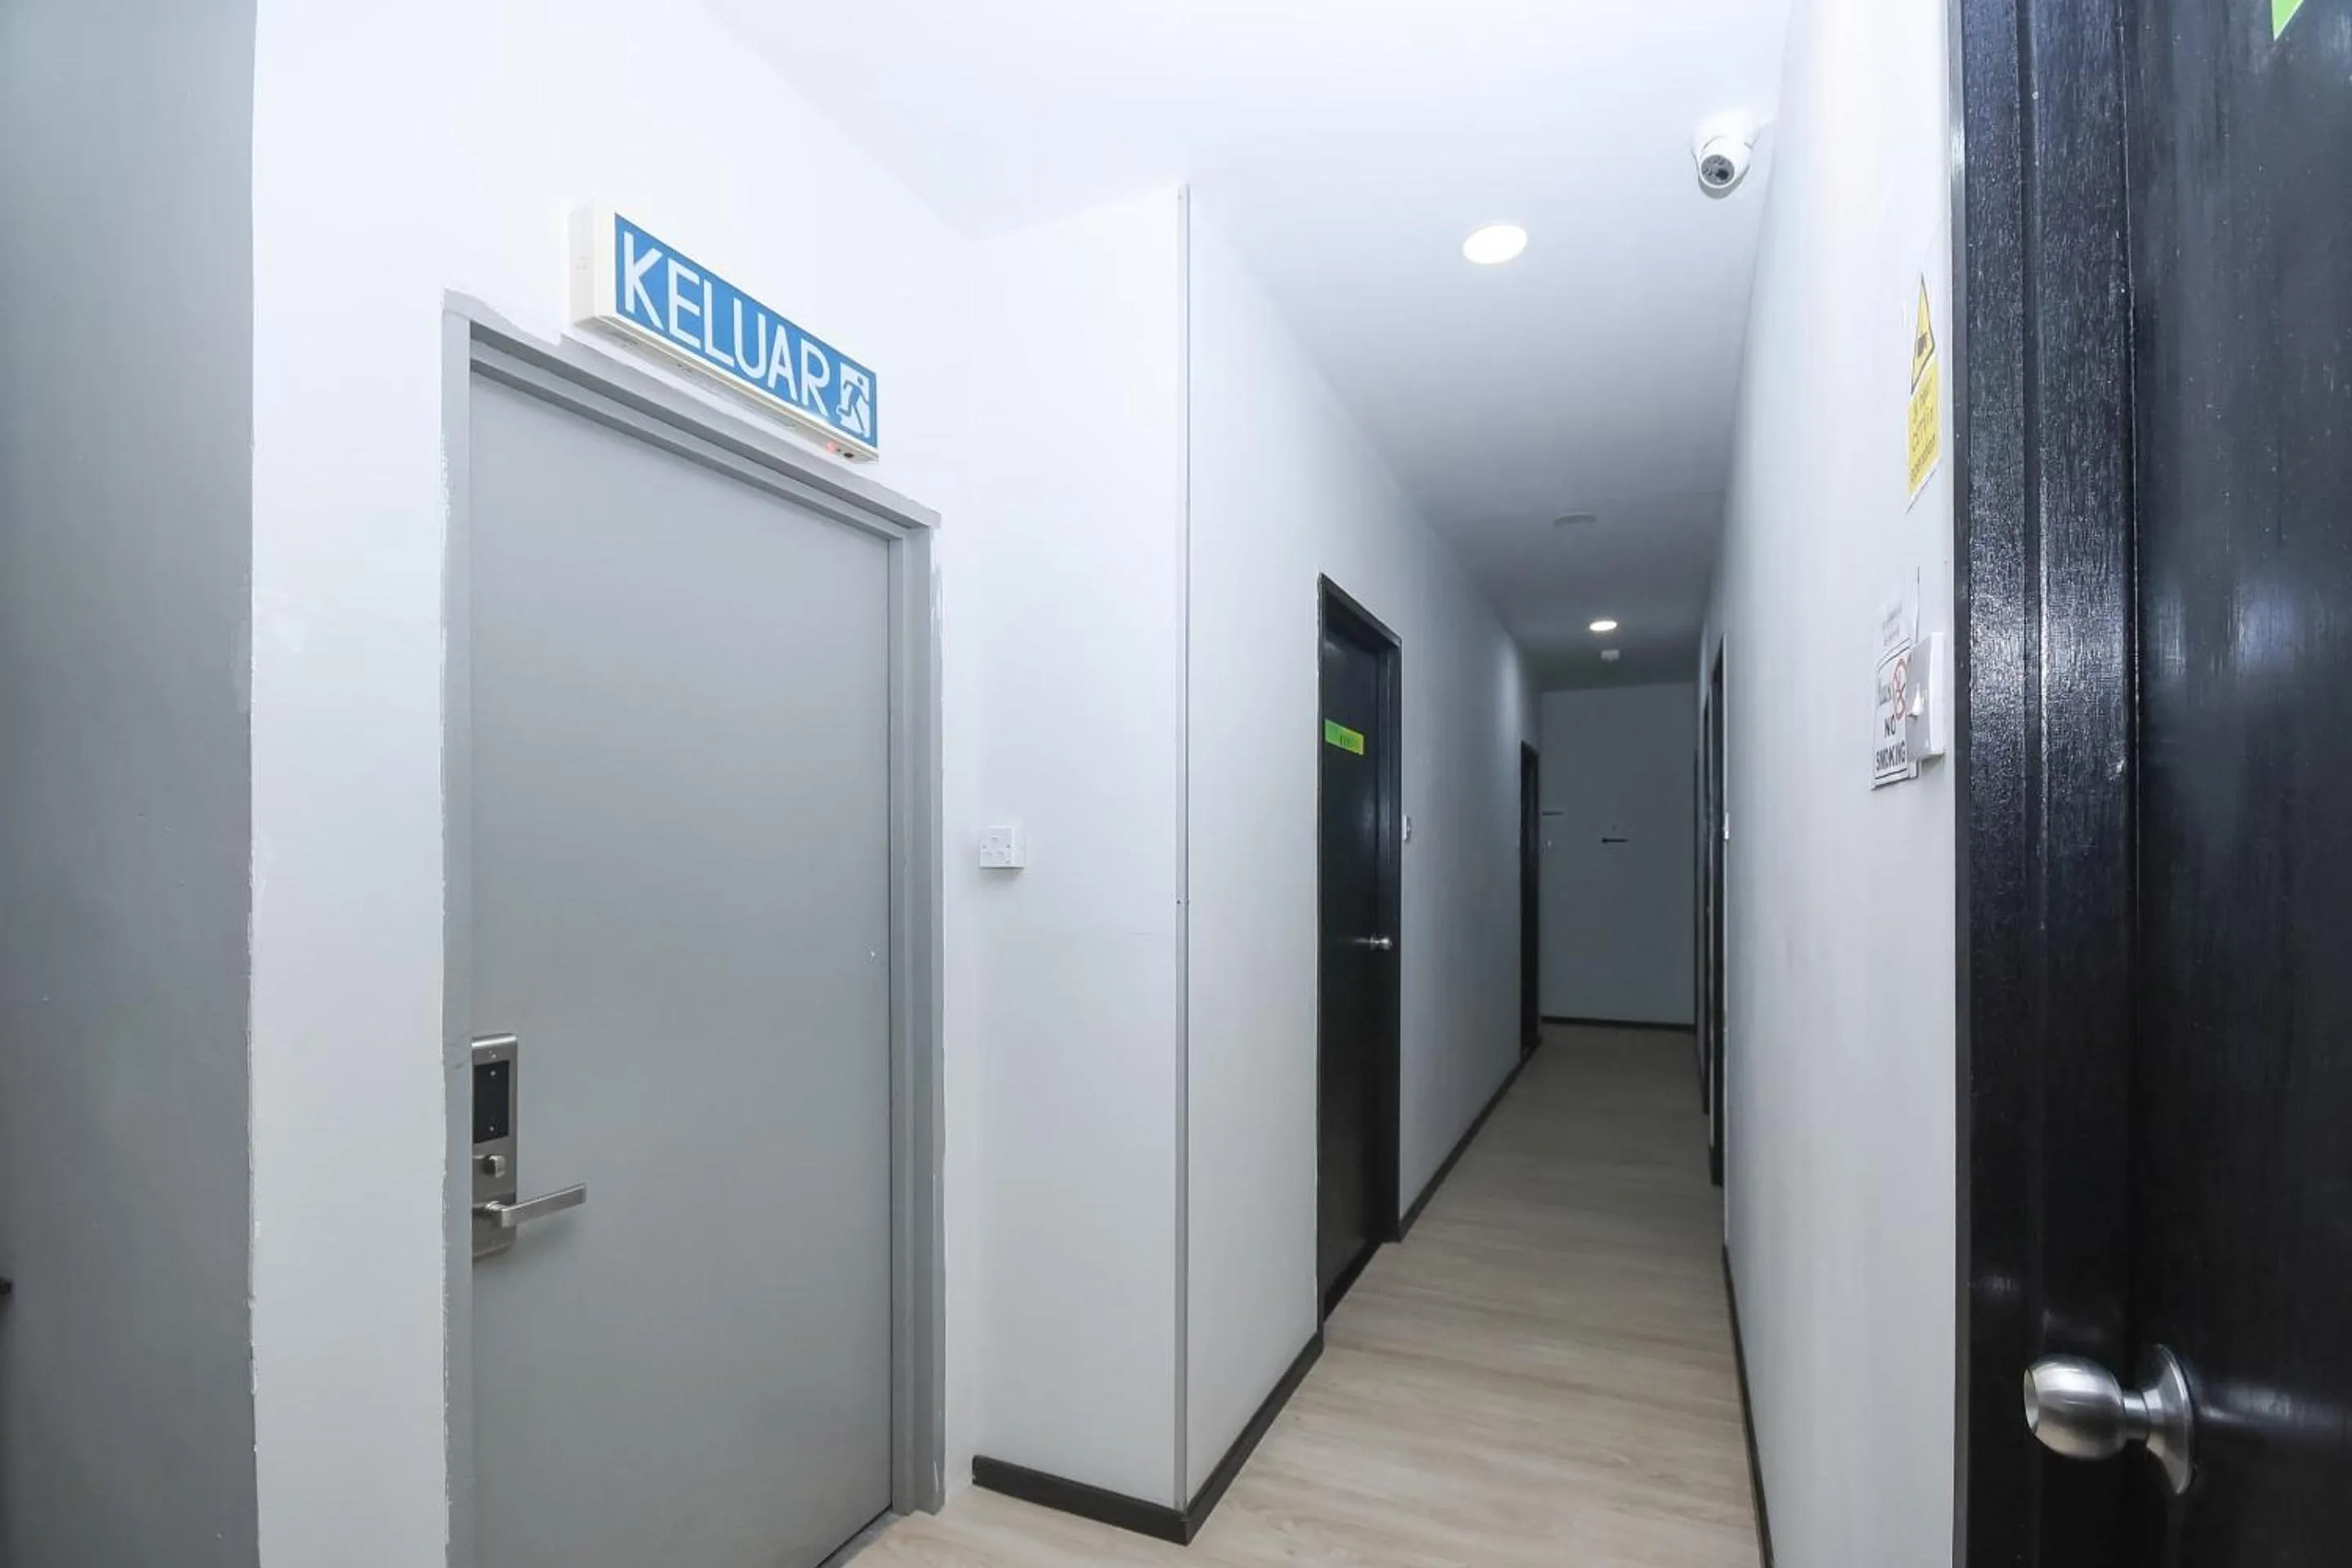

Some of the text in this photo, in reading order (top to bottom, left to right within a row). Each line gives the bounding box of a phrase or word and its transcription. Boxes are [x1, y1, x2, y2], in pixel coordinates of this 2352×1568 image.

[623, 230, 831, 417] KELUAR
[1884, 714, 1896, 738] NO
[1876, 740, 1906, 771] SMOKING
